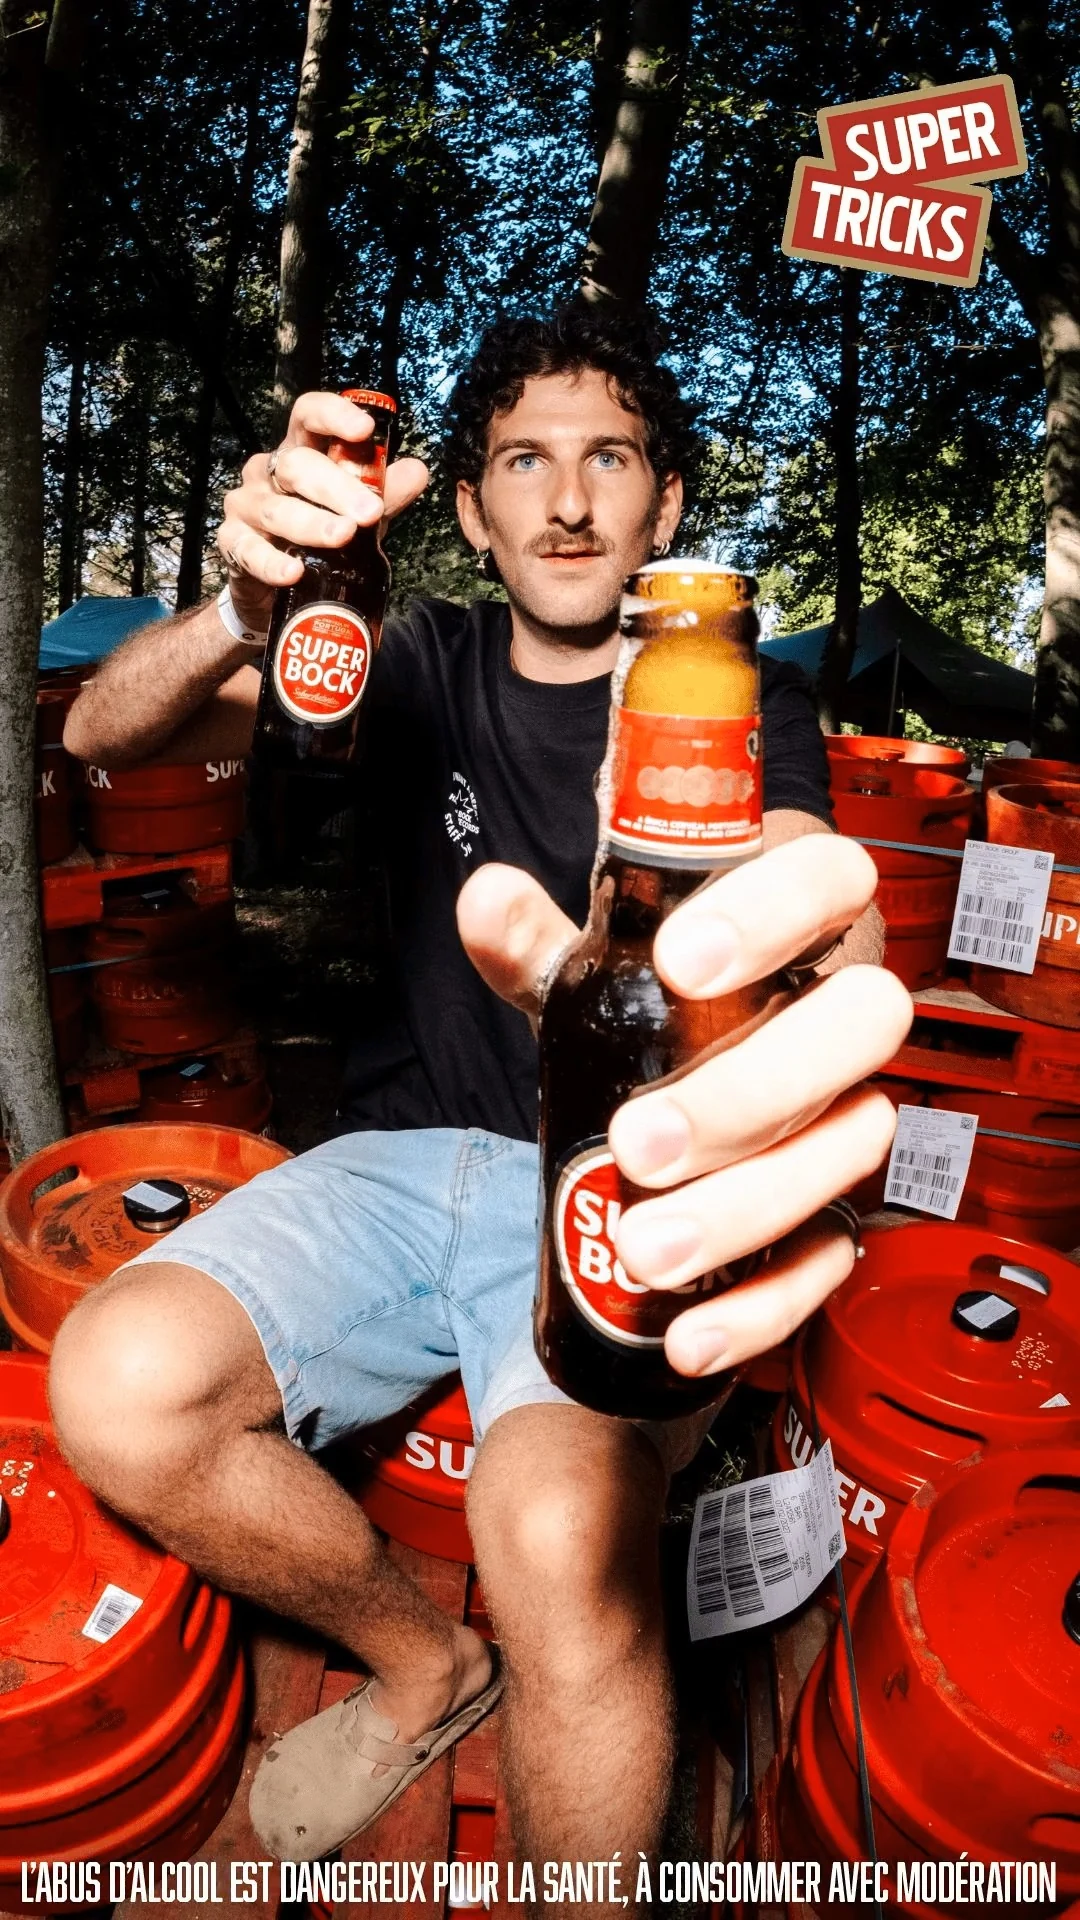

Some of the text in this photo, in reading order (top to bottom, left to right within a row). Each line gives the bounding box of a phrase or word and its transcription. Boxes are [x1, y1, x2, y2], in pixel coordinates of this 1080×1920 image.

[287, 632, 365, 672] SUPER
[285, 656, 358, 695] BOCK
[85, 764, 113, 789] CK
[206, 759, 245, 783] SUP
[444, 812, 462, 842] STAFF
[783, 1405, 886, 1536] SUER
